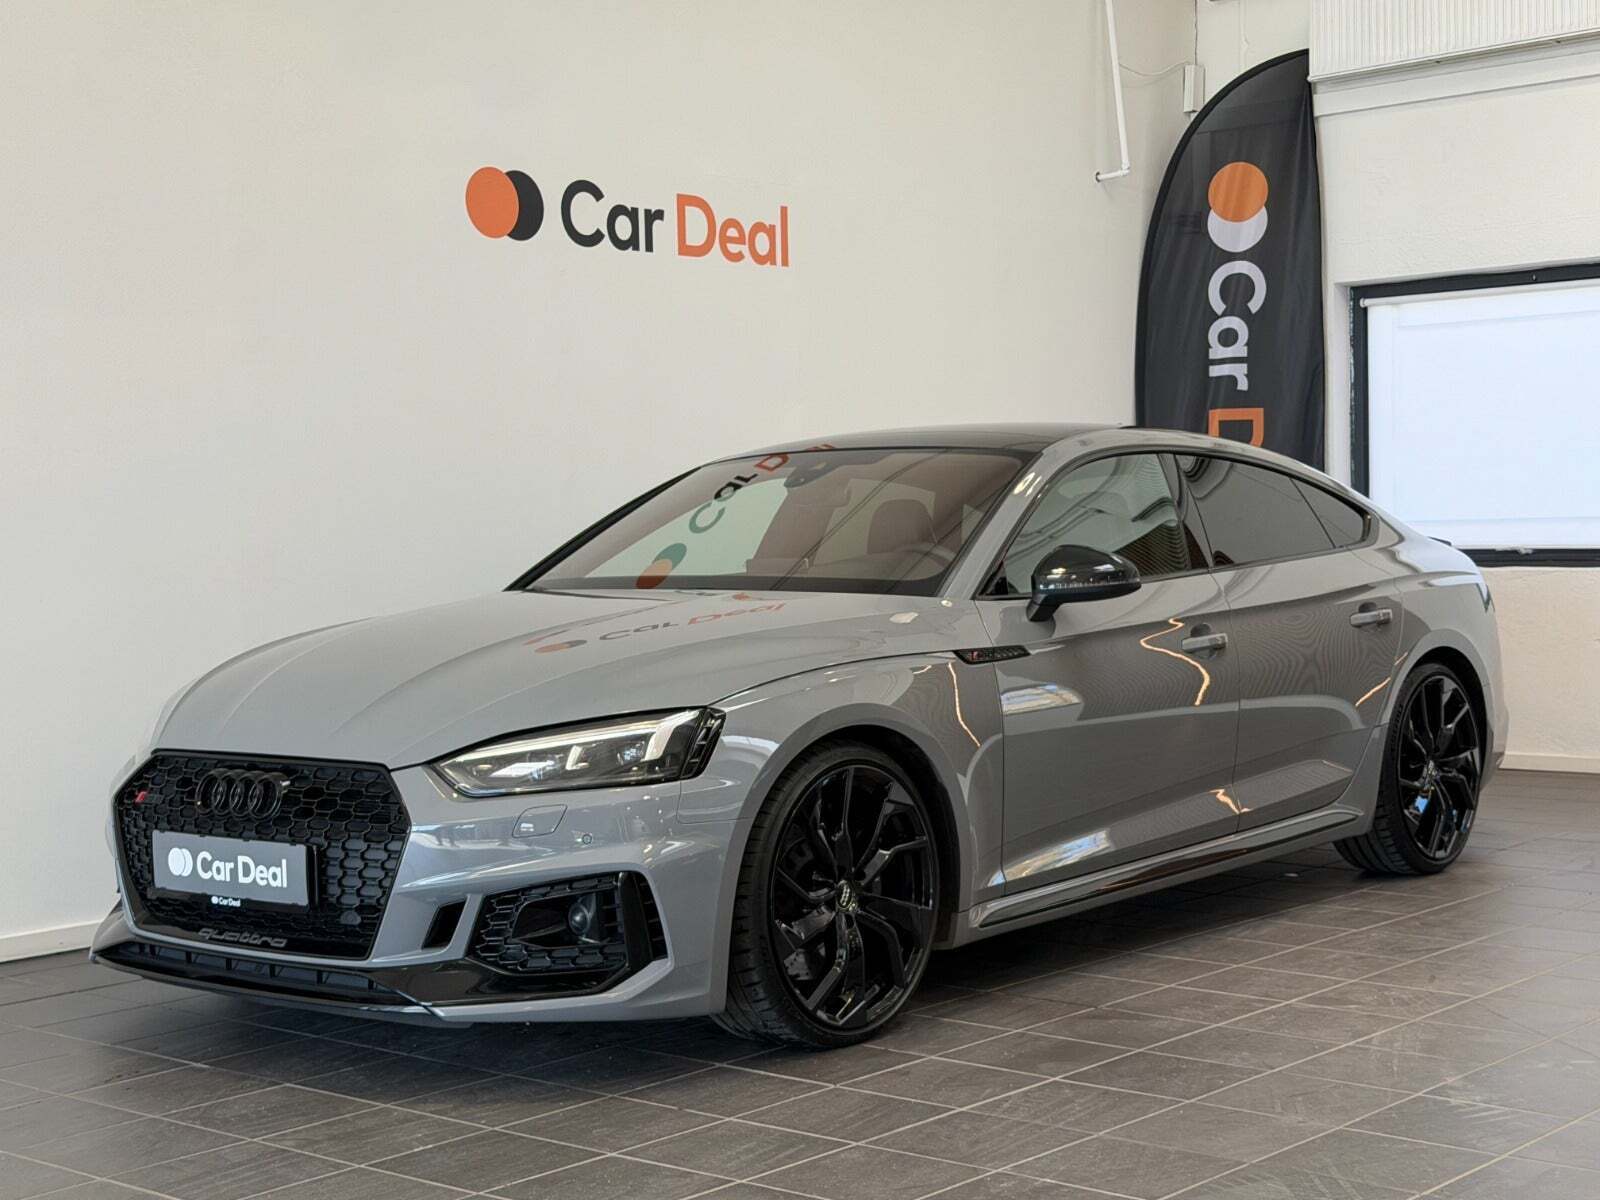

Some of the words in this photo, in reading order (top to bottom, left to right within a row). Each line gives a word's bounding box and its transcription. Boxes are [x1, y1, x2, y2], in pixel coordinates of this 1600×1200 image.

[561, 179, 665, 253] Car
[676, 193, 789, 267] Deal
[1207, 260, 1267, 391] Car
[196, 851, 234, 882] Car
[237, 855, 288, 888] Deal
[198, 927, 288, 948] quattro
